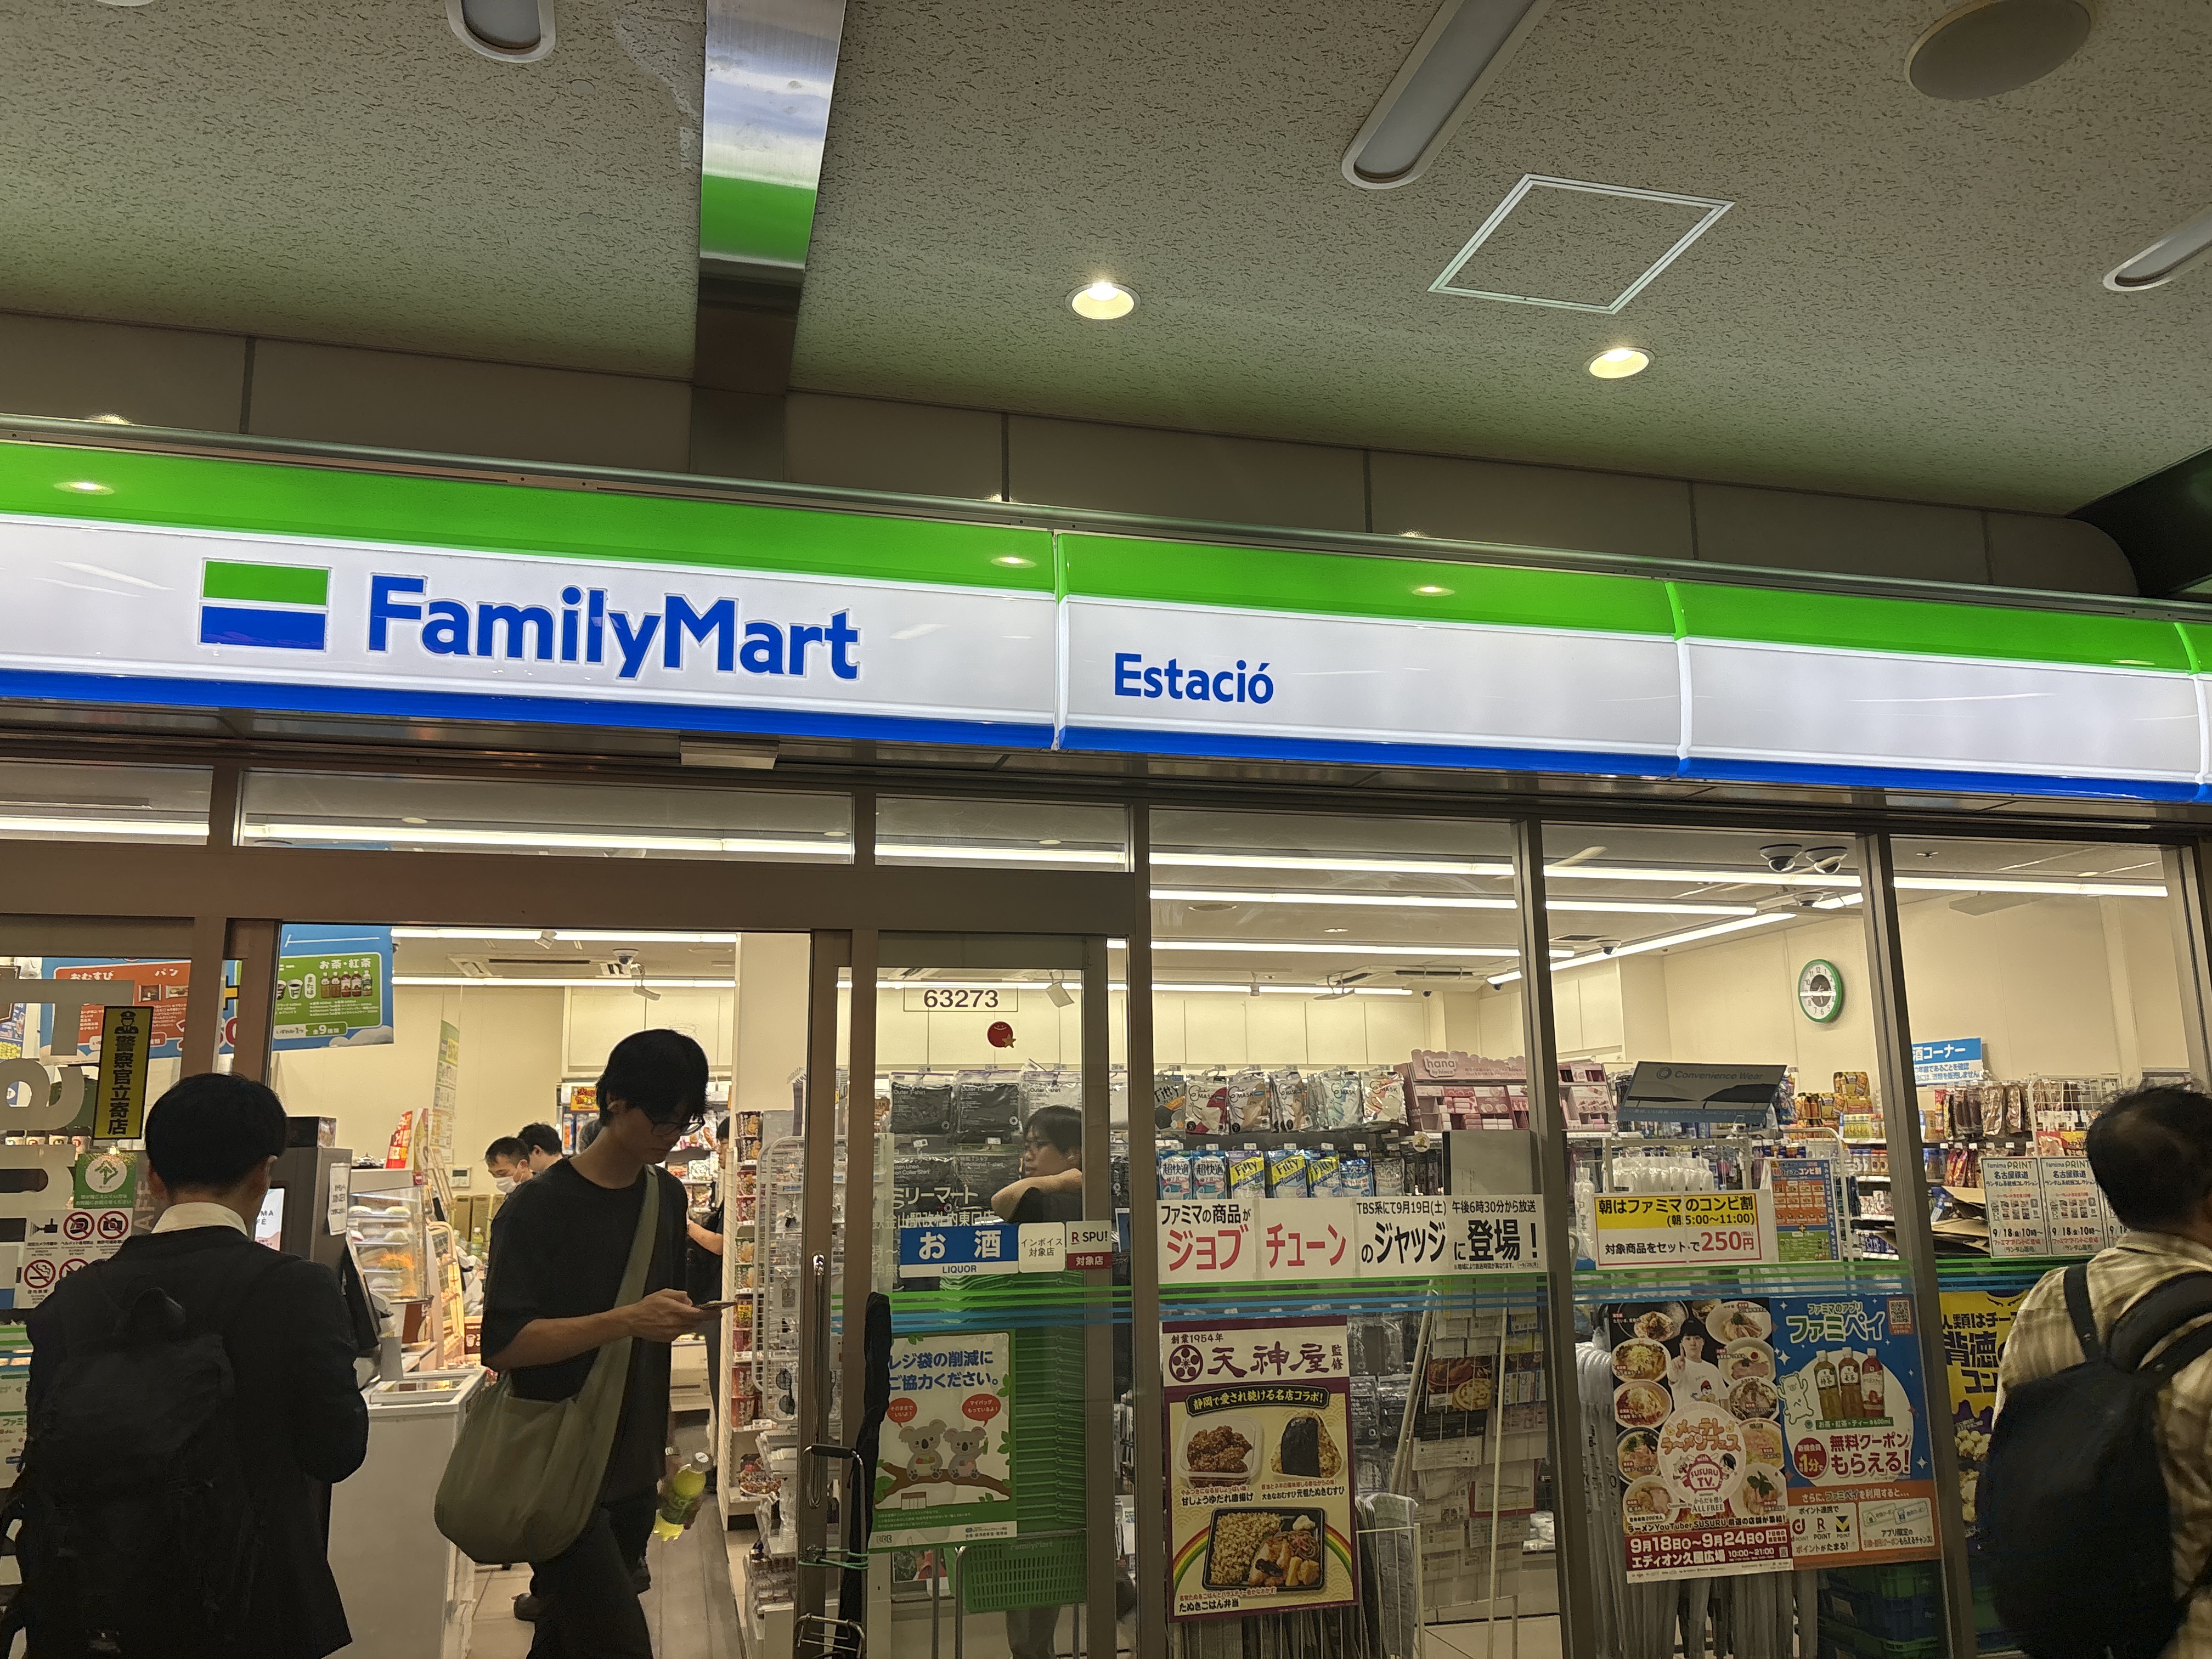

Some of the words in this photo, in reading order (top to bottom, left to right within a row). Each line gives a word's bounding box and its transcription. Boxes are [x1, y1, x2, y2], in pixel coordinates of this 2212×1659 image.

[367, 575, 860, 680] FamilyMart
[1115, 652, 1273, 704] Estació
[154, 968, 178, 977] パン
[924, 989, 998, 1008] 63273
[1427, 1058, 1455, 1069] hana
[1675, 1070, 1736, 1080] Convenience
[1739, 1072, 1763, 1080] Wear
[107, 1036, 137, 1135] 警察官立寄店
[1163, 1163, 1189, 1176] 超快適
[1197, 1163, 1223, 1176] 超快適
[1276, 1158, 1299, 1175] Fitty
[2007, 1160, 2033, 1170] PRINT
[2065, 1160, 2090, 1169] PRINT
[1356, 1200, 1446, 1216] TBS系にて9月19日(土)
[1452, 1200, 1536, 1215] 午後6時30分から放送
[1599, 1195, 1753, 1215] 朝はファミマのコンビ割
[1161, 1204, 1251, 1225] ファミマの商品が
[1021, 1238, 1063, 1248] インボイス
[1167, 1223, 1249, 1271] ジョブ
[1266, 1223, 1347, 1269] チューン
[1029, 1248, 1055, 1257] 対象店
[1076, 1255, 1104, 1266] 対象店
[942, 1265, 977, 1274] LIQUOR
[1808, 1301, 1863, 1314] ファミマのアプリ
[1786, 1312, 1885, 1344] ファミペイ
[1171, 1332, 1224, 1345] 創業1954年
[889, 1350, 994, 1370] レジ袋の削減に
[1207, 1341, 1330, 1378] 天神屋
[1331, 1344, 1344, 1370] 監修
[889, 1372, 998, 1391] ご協力ください。
[1830, 1431, 1909, 1452] 無料クーポン
[1690, 1468, 1719, 1478] SUSURU
